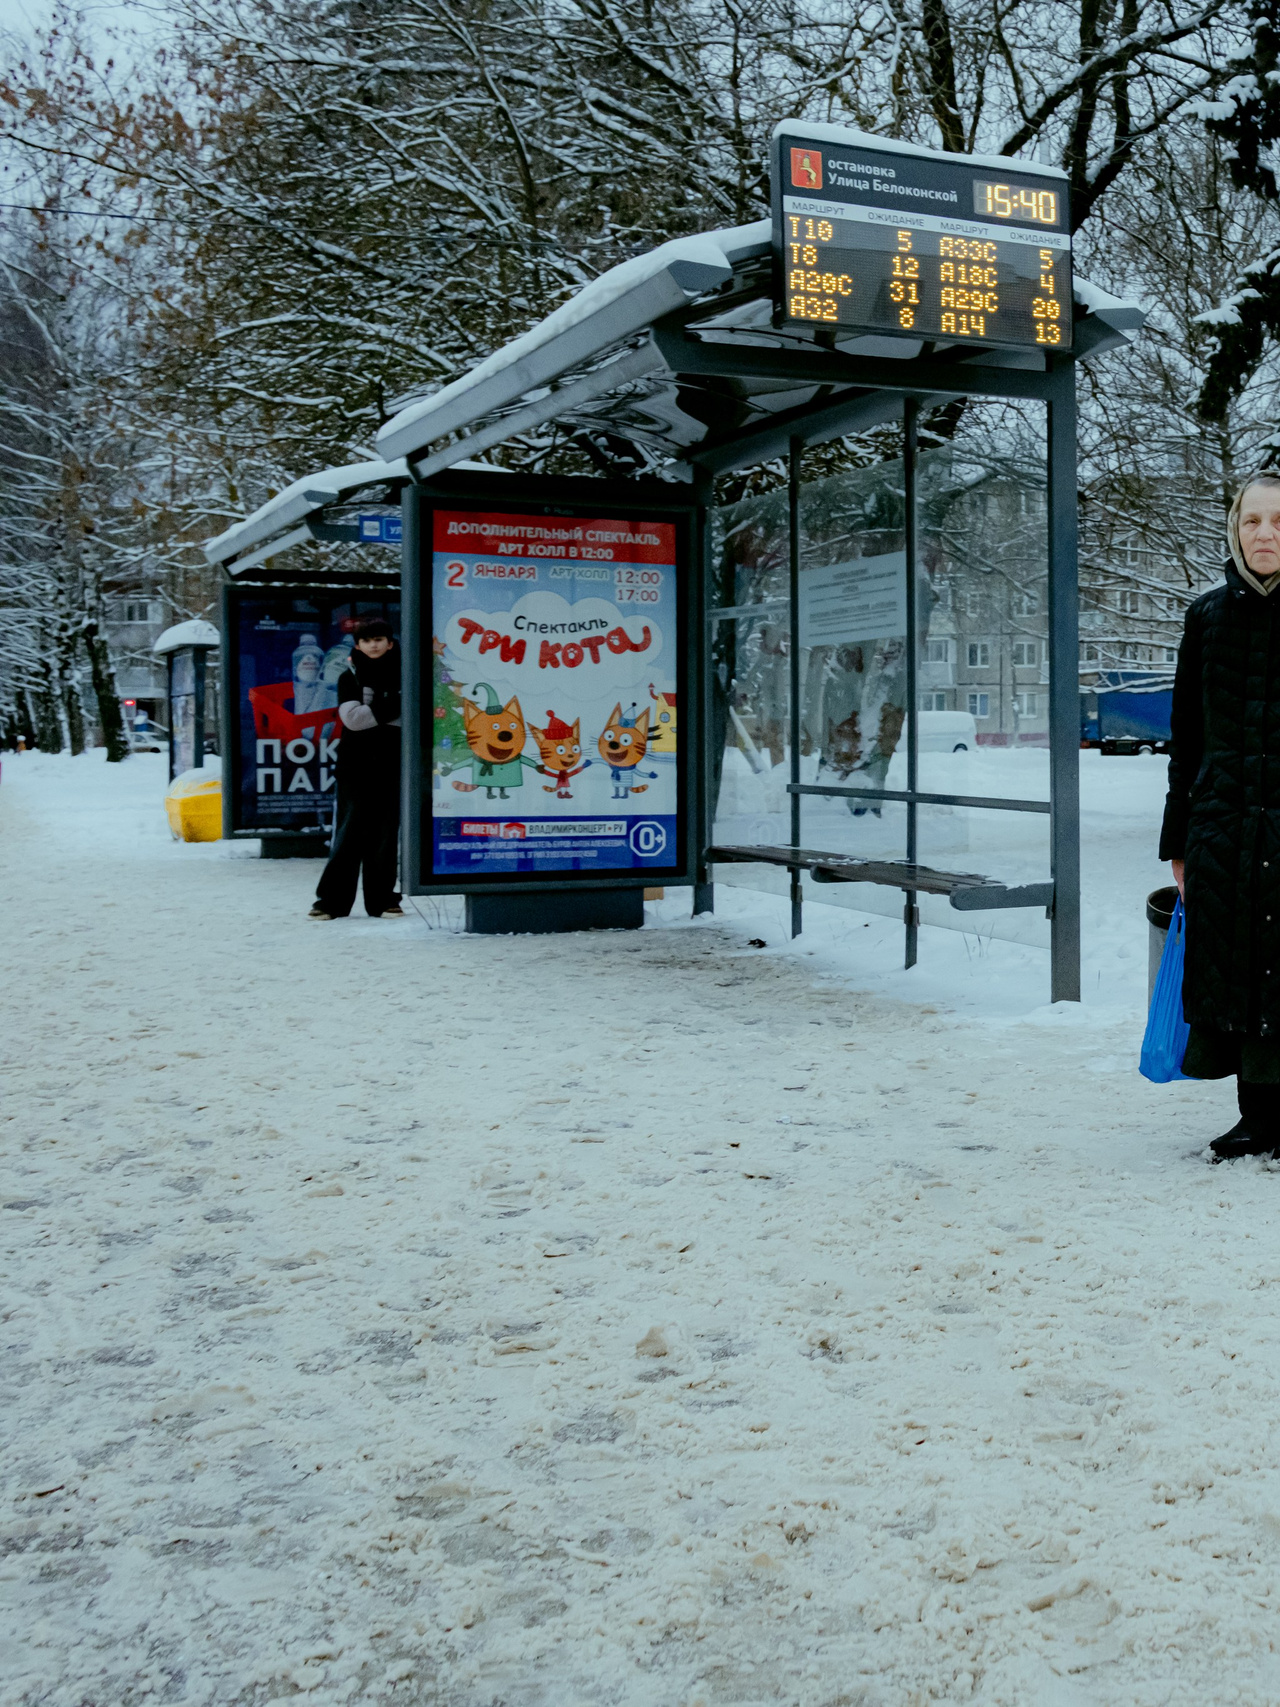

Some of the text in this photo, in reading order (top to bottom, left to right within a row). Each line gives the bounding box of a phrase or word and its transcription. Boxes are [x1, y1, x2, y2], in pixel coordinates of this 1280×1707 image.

[828, 159, 896, 178] остановка
[828, 172, 958, 203] Улица Белоконской
[986, 184, 1056, 223] 15:40
[792, 202, 1062, 247] МАРШРУТ ОЖИДАНИЕ МАРШРУТ ОЖИДАНИЕ
[789, 215, 1055, 270] Т10 5 А33С 5
[789, 242, 1055, 295] Т8 12 А18С 4
[889, 281, 920, 305] 31
[940, 287, 999, 313] А29С
[1032, 297, 1060, 320] 20
[790, 295, 1061, 344] А32 8 А14 13
[447, 521, 660, 546] ДОПОЛНИТЕЛЬНЫЙ СПЕКТАКЛЬ
[498, 543, 614, 560] АРТ ХОЛЛ В 12:00
[447, 562, 660, 588] 2 ЯНВАРЯ АРТ ХОЛЛ 12:00
[617, 589, 659, 603] 17:00
[514, 615, 608, 634] Спектакль
[458, 617, 652, 669] ТРИ КОТА
[462, 823, 498, 835] БИЛЕТЫ
[639, 827, 664, 850] 0+
